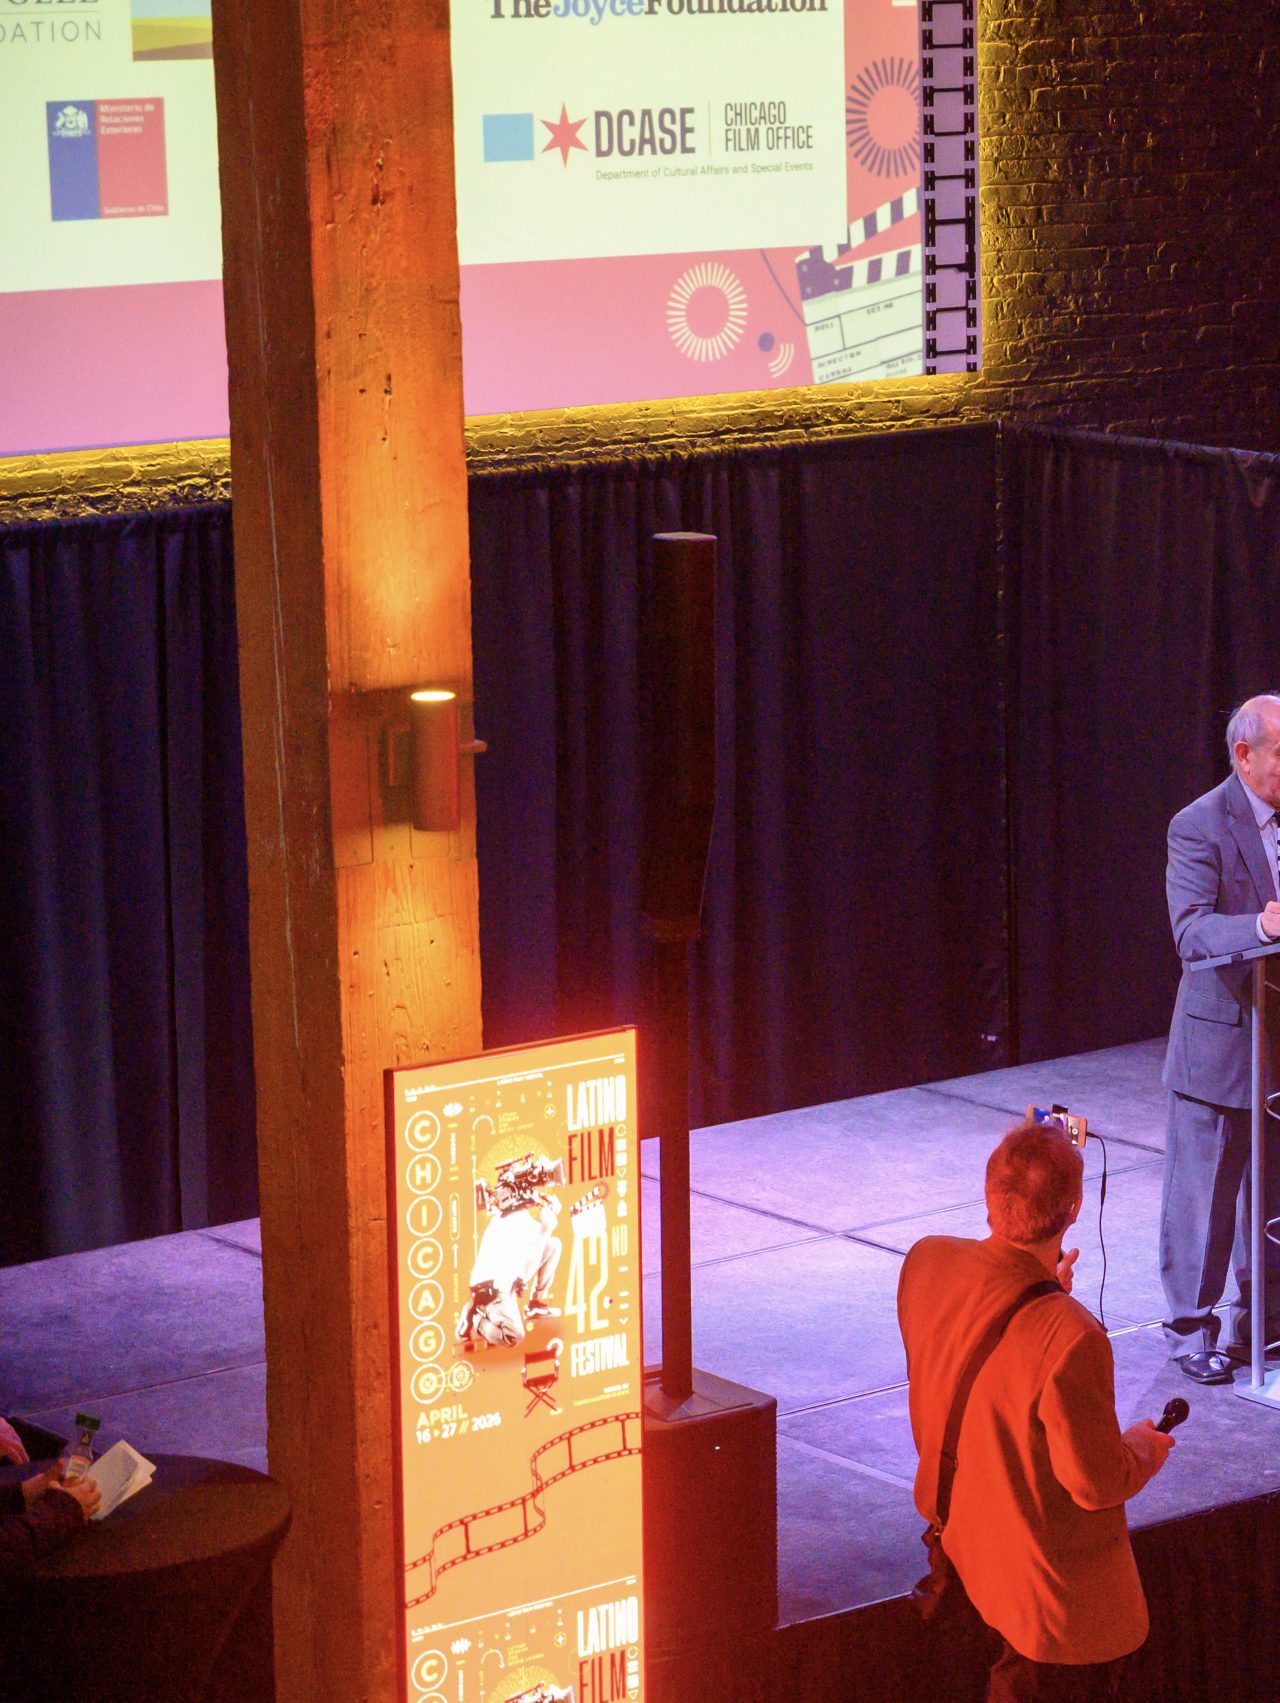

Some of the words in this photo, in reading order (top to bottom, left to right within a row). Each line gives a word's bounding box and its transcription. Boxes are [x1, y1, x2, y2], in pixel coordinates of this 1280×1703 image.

[594, 107, 696, 158] DCASE
[724, 101, 787, 126] CHICAGO
[725, 128, 760, 152] FILM
[766, 125, 814, 150] OFFICE
[596, 169, 649, 182] Department
[651, 167, 661, 178] of
[663, 166, 698, 177] Cultural
[699, 164, 730, 176] Affairs
[732, 164, 748, 175] and
[750, 162, 782, 174] Special
[784, 161, 814, 172] Events
[566, 1073, 627, 1132] LATINO
[567, 1126, 615, 1185] FILM
[611, 1223, 629, 1258] ND
[570, 1332, 630, 1378] FESTIVAL
[416, 1403, 468, 1430] APRIL
[416, 1428, 431, 1445] 16
[441, 1422, 457, 1439] 27
[471, 1411, 502, 1432] 2026
[577, 1595, 639, 1658] LATINO
[579, 1649, 626, 1703] FILM
